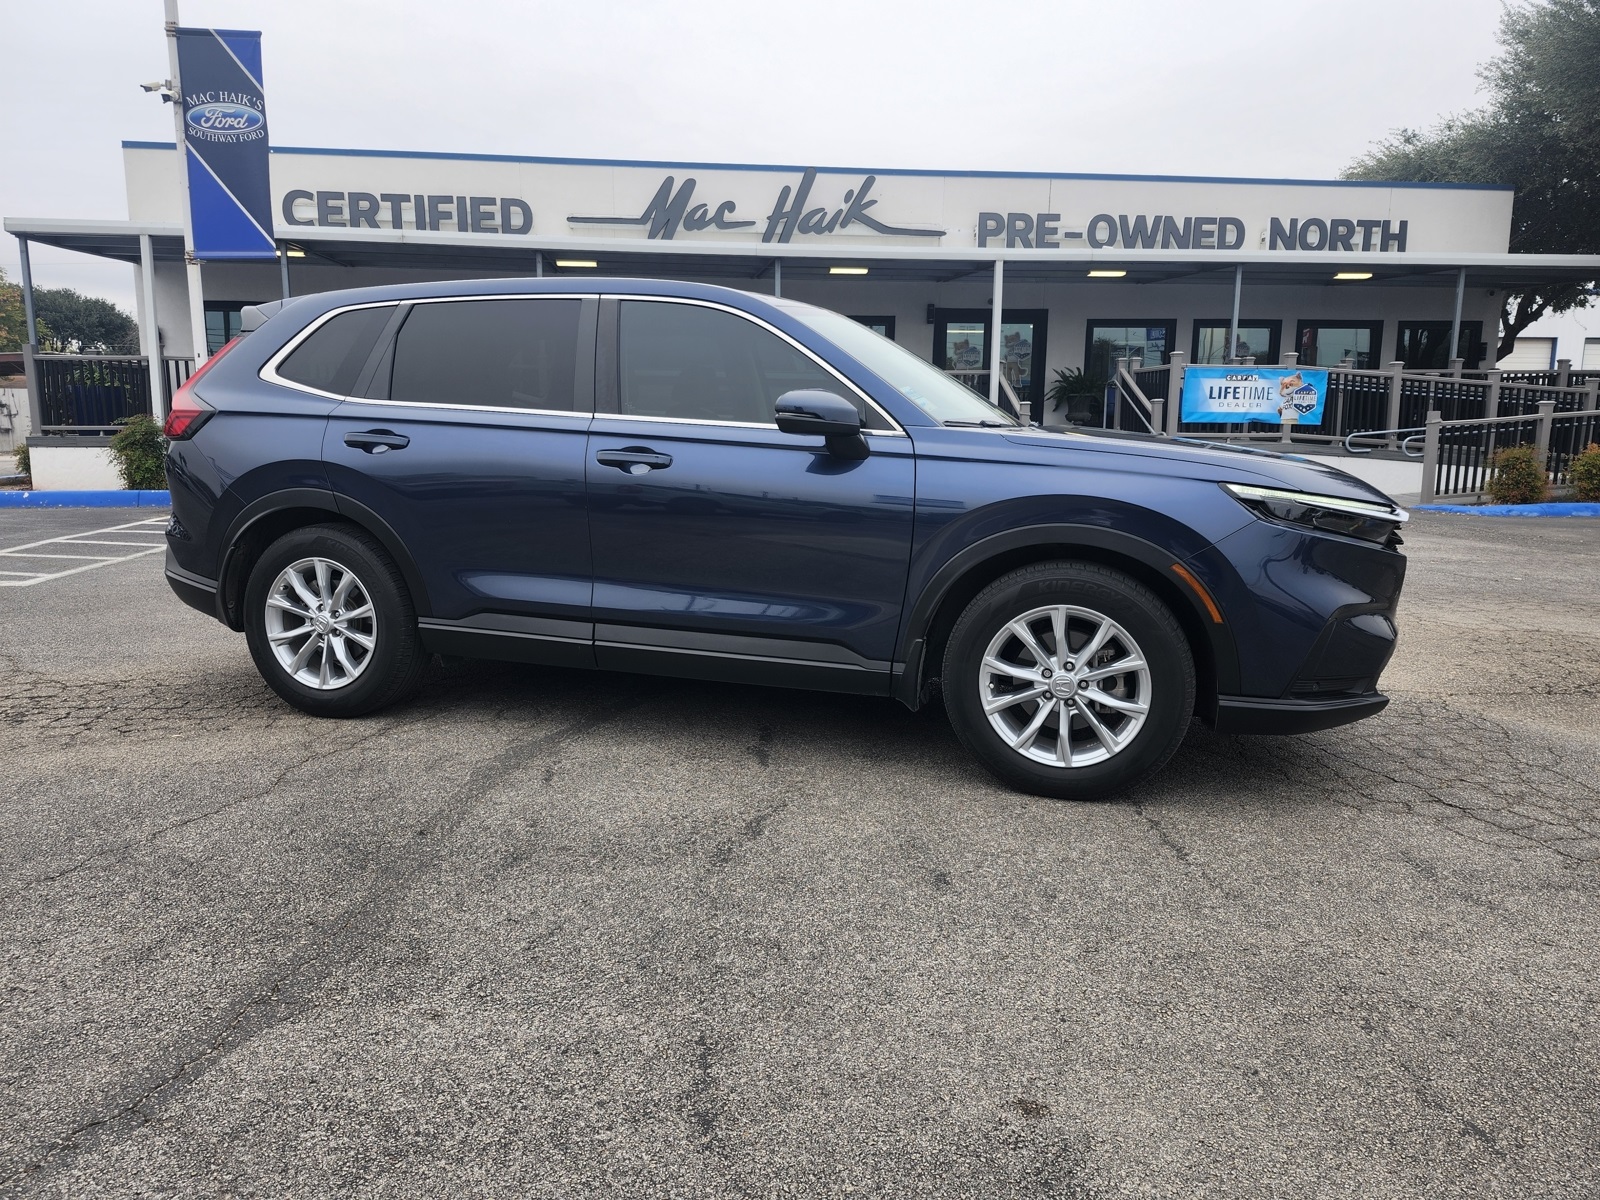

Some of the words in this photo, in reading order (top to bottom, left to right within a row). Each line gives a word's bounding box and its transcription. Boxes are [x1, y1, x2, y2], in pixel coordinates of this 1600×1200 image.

[186, 91, 215, 107] MAC
[219, 91, 263, 111] HAIK'S
[201, 107, 248, 128] Ford
[188, 127, 237, 142] SOUTHWAY
[240, 129, 265, 142] FORD
[282, 189, 533, 235] CERTIFIED
[567, 176, 755, 240] Mac
[762, 167, 946, 243] Haik
[977, 212, 1246, 250] PRE-OWNED
[1269, 216, 1409, 253] NORTH
[1208, 386, 1274, 401] LIFETIME
